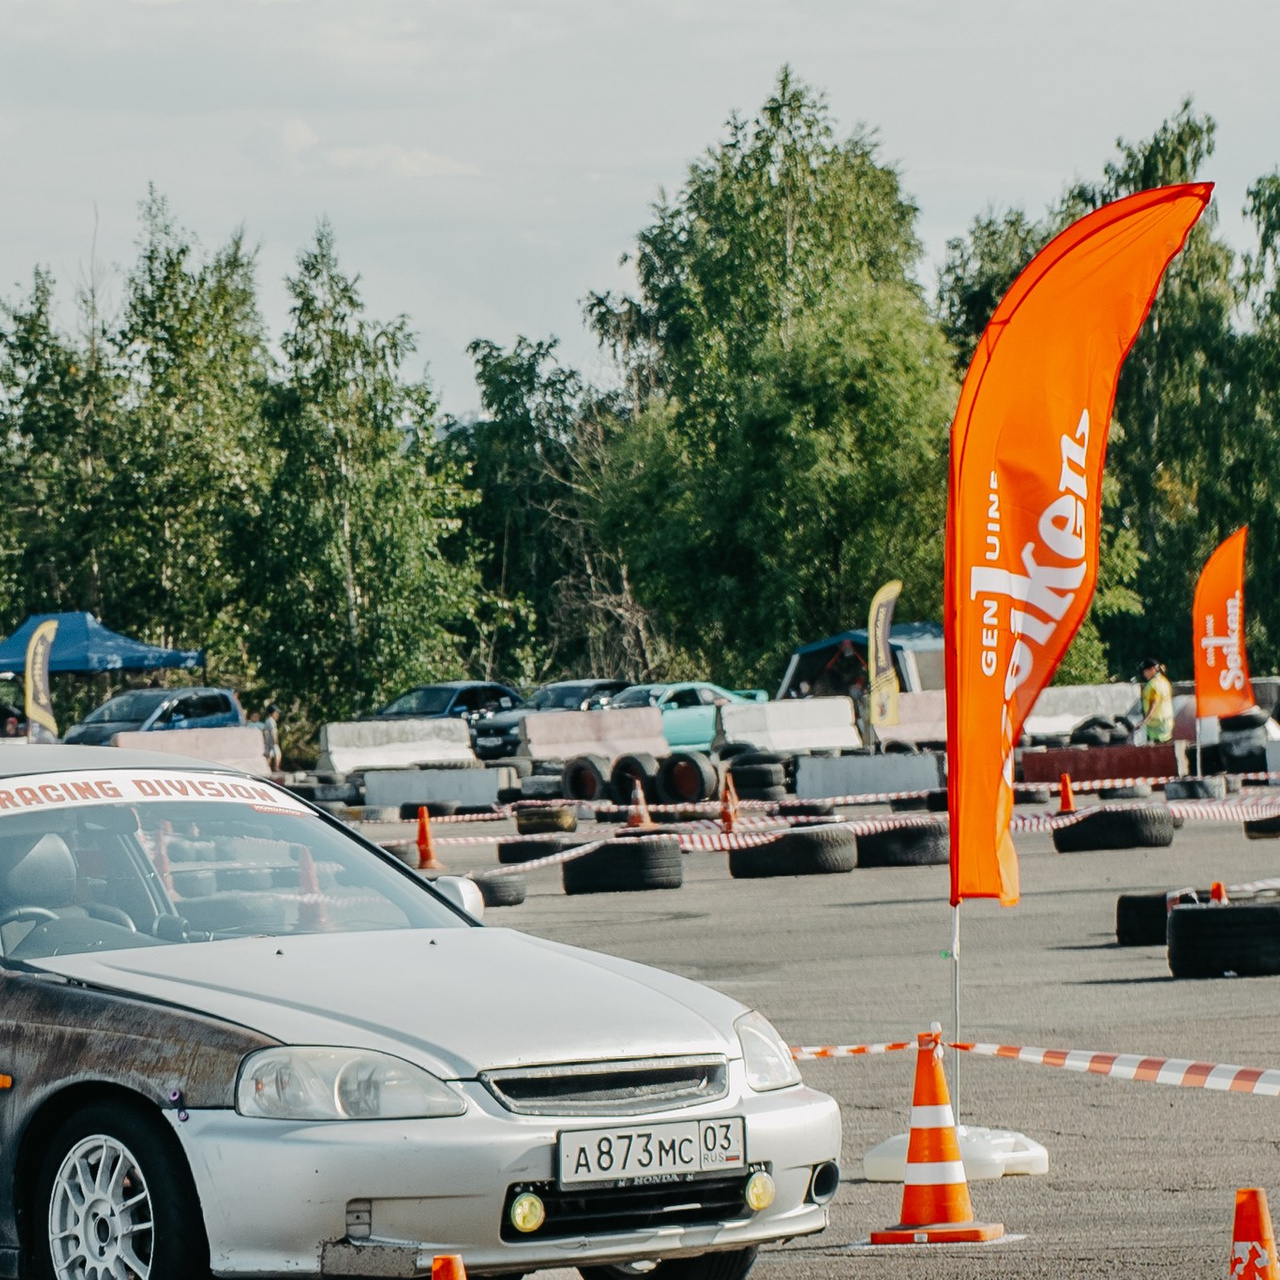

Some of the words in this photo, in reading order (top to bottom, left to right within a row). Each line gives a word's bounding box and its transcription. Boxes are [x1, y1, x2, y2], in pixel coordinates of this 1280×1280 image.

[132, 778, 278, 804] DIVISION
[703, 1151, 724, 1163] RUS
[633, 1173, 678, 1186] HONDA
